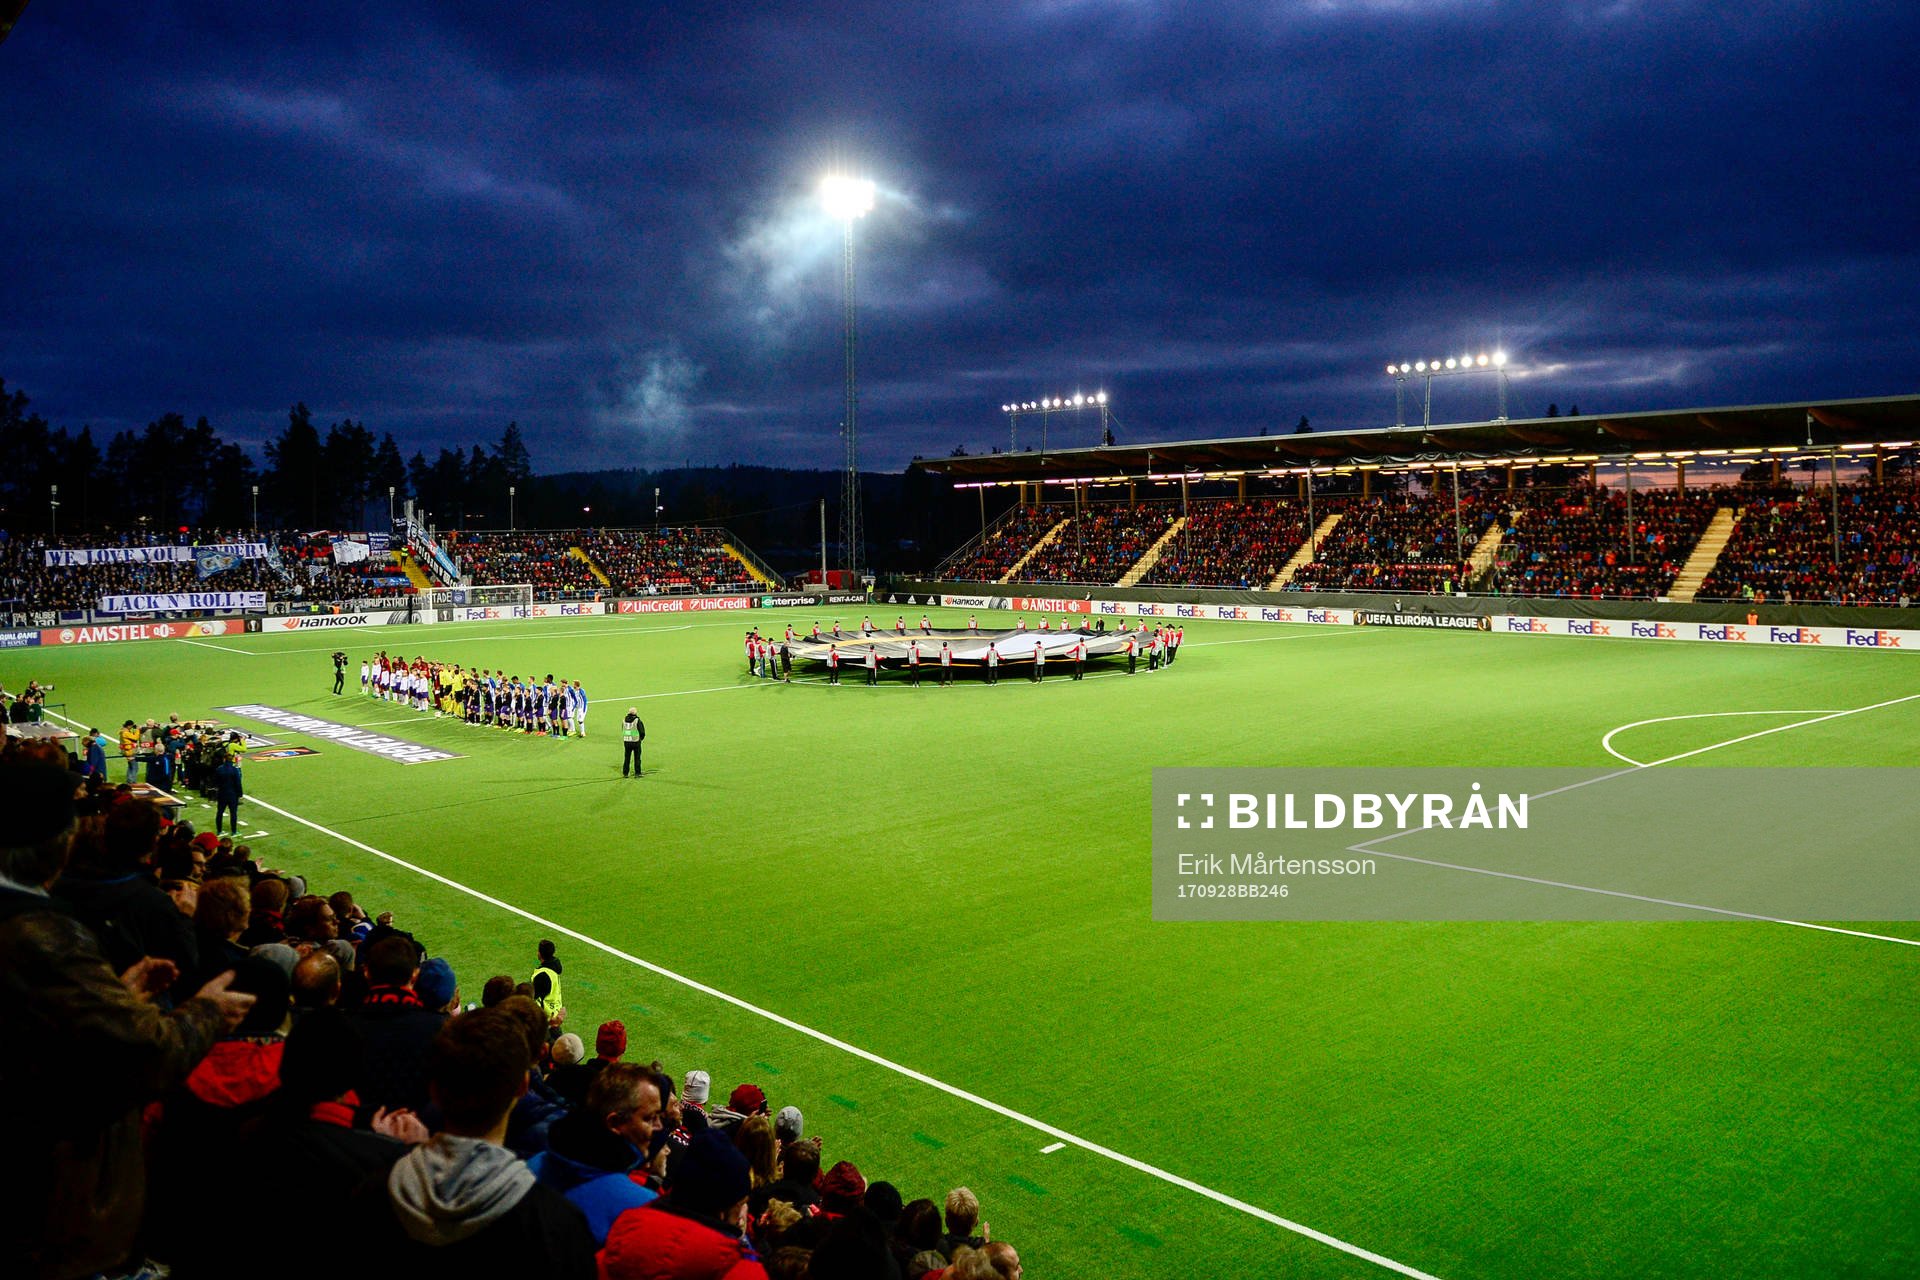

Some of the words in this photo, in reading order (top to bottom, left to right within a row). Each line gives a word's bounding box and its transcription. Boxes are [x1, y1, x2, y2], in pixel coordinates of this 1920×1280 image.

[49, 551, 75, 564] WE
[87, 549, 133, 563] LOVE
[141, 547, 178, 561] YOU
[634, 600, 683, 613] UniCredit
[701, 598, 747, 610] UniCredit
[763, 595, 815, 606] enterprise
[1030, 599, 1066, 612] AMSTEL
[466, 607, 500, 620] FedEx
[514, 604, 547, 618] FedEx
[561, 603, 593, 615] FedEx
[1101, 603, 1125, 614] FedEx
[1138, 604, 1164, 616] FedEx
[1177, 605, 1205, 618] FedEx
[1219, 607, 1247, 620] FedEx
[1262, 608, 1292, 621] FedEx
[1307, 609, 1339, 624] FedEx
[1366, 614, 1392, 625] UEFA
[1394, 615, 1434, 627] EUROPA
[1436, 616, 1478, 628] LEAGUE
[1508, 617, 1548, 632] FedEx
[1568, 619, 1611, 635] FedEx
[1631, 622, 1677, 638] FedEx
[77, 625, 150, 643] AMSTEL
[1699, 624, 1747, 641] FedEx
[1770, 626, 1822, 644] FedEx
[1846, 629, 1901, 648] FedEx
[336, 734, 454, 762] LEAGUE
